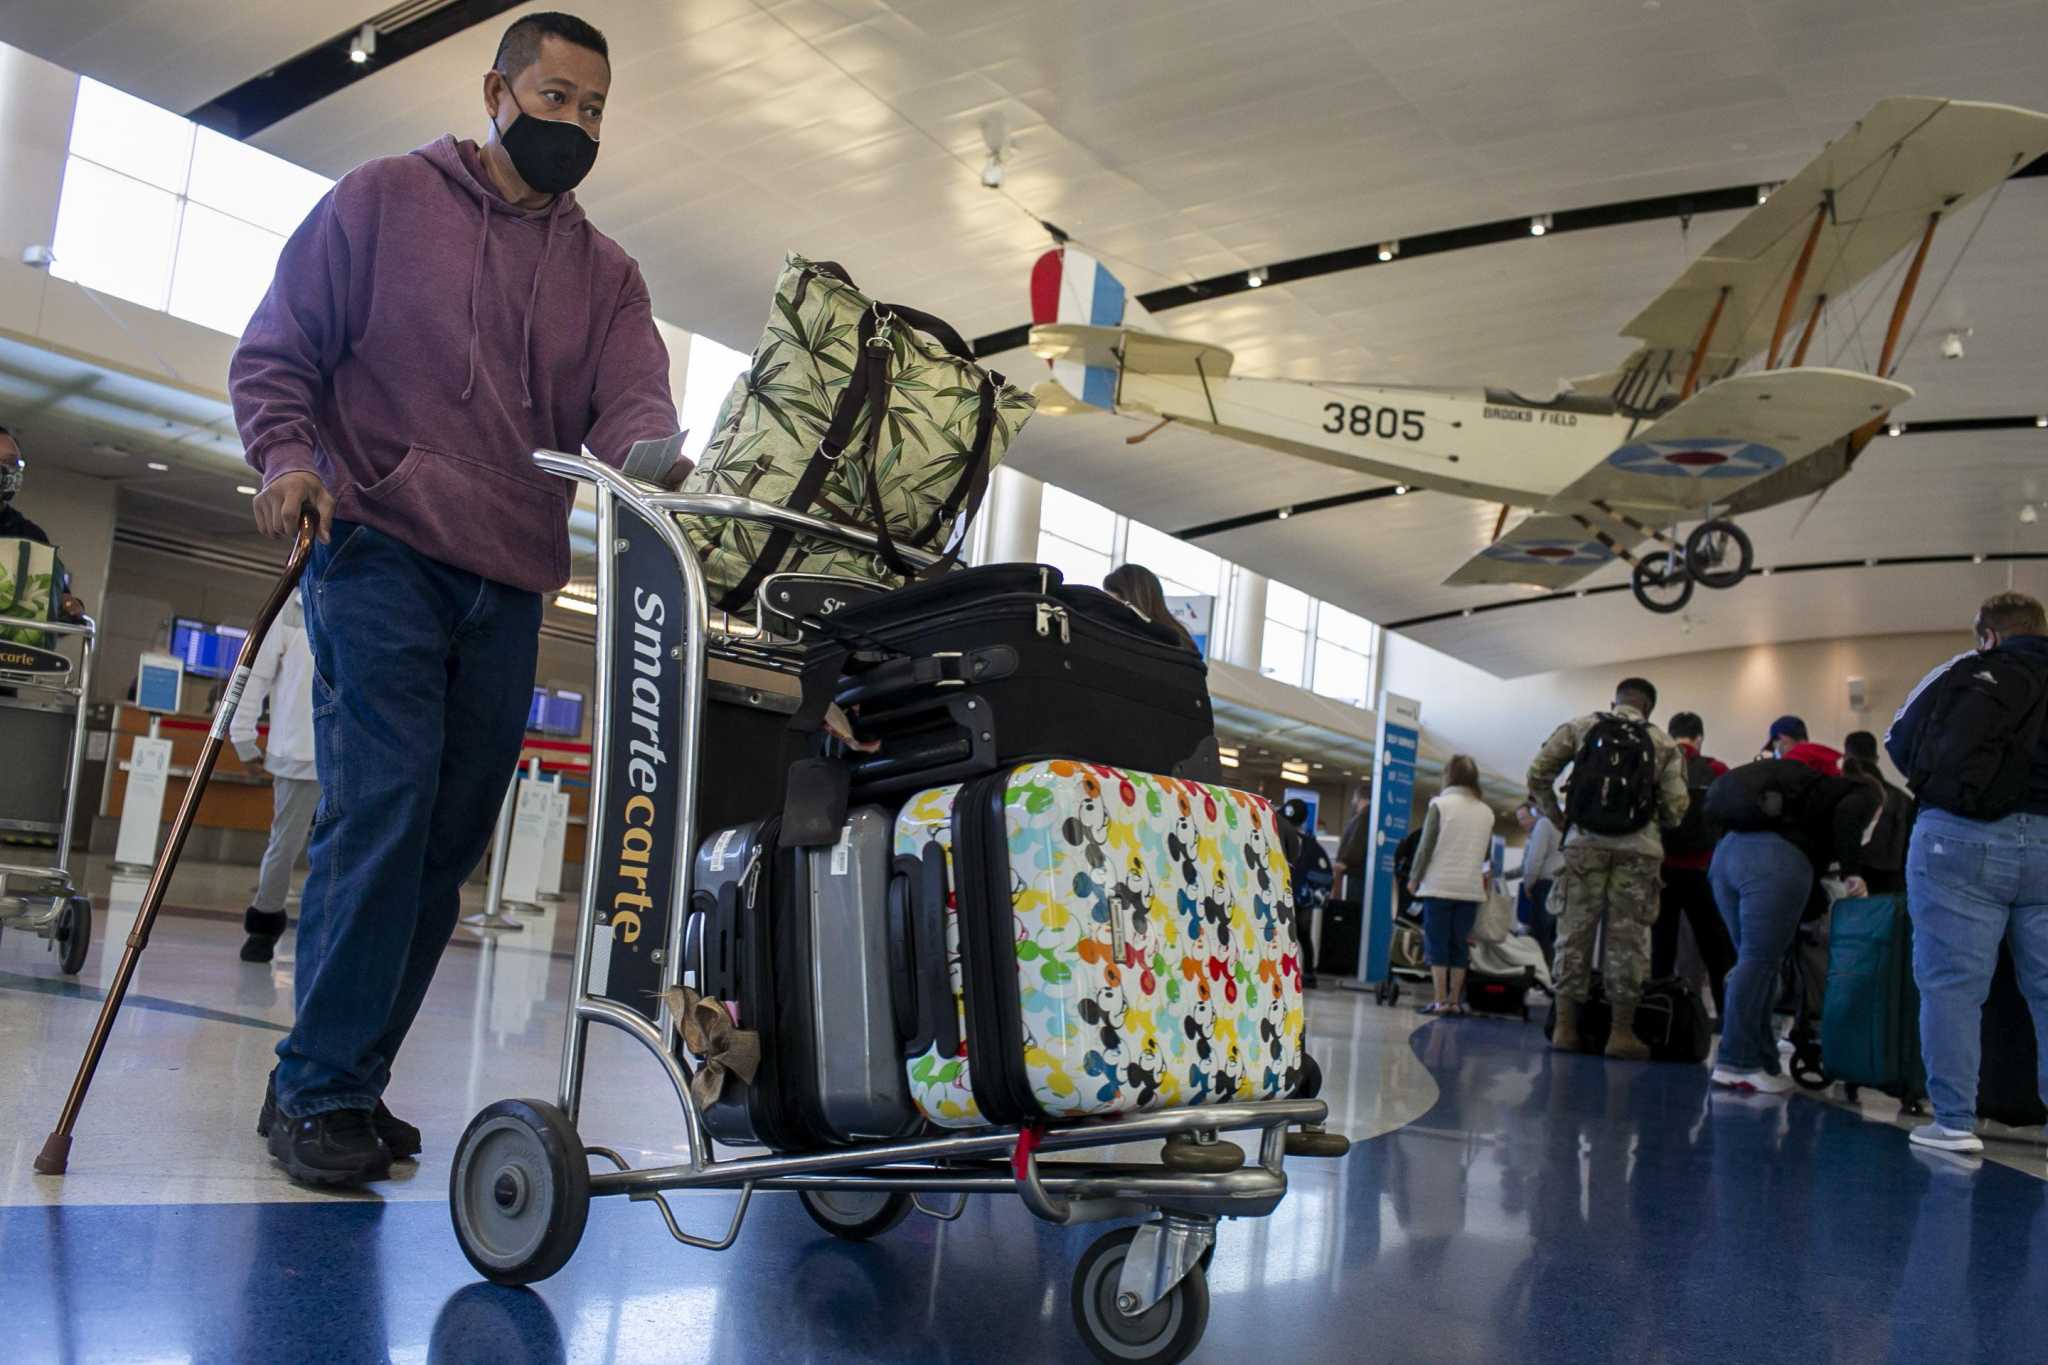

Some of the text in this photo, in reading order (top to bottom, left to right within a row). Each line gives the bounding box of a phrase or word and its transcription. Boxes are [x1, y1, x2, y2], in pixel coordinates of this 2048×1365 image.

[1322, 402, 1425, 441] 3805
[1483, 406, 1577, 427] BROOKS FIELD
